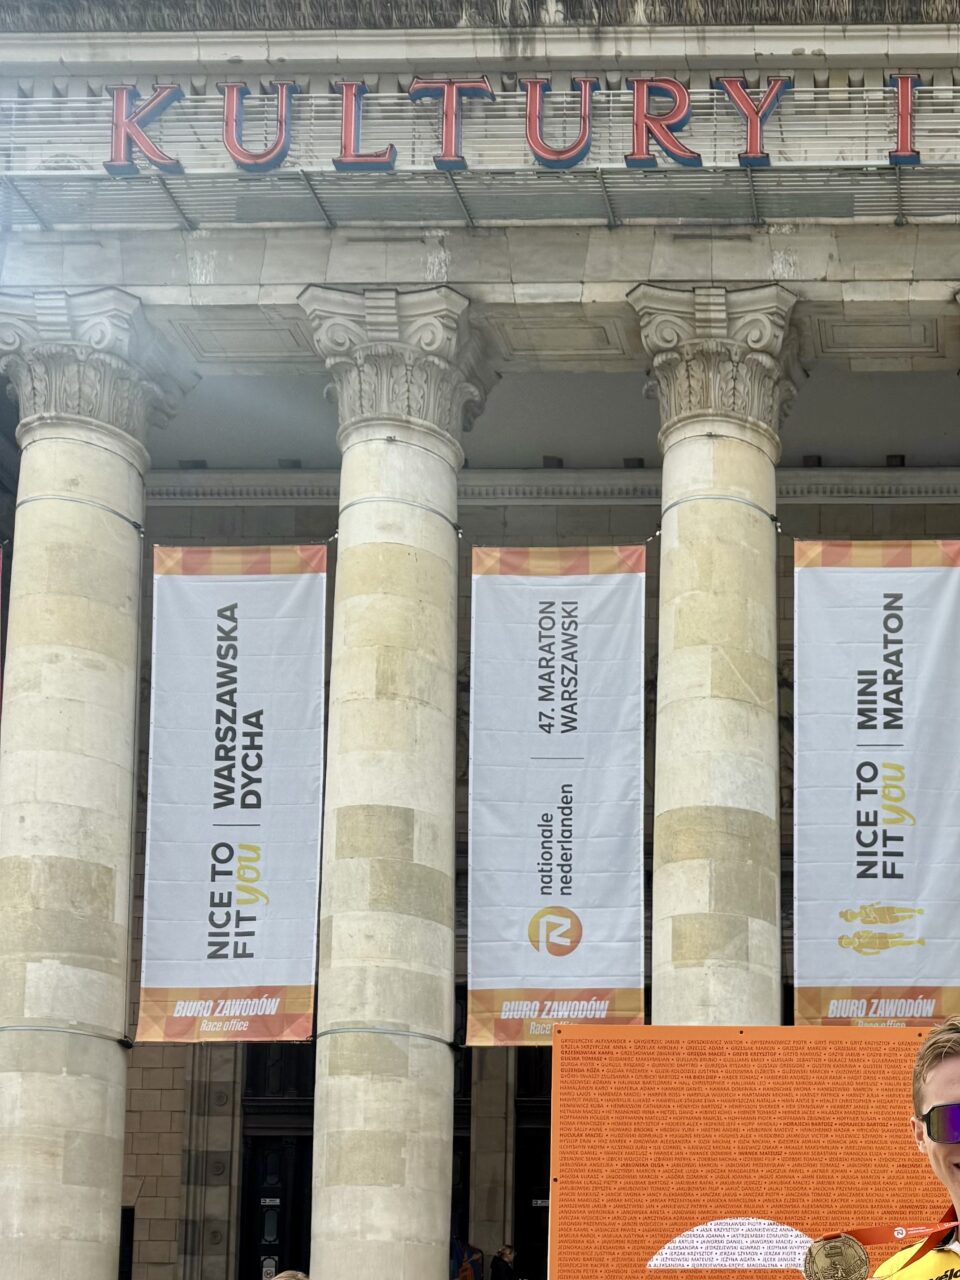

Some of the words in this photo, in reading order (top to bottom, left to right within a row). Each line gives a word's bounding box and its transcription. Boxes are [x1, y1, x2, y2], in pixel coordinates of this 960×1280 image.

[103, 74, 793, 174] KULTURY
[888, 73, 921, 165] I
[538, 601, 555, 701] MARATON
[561, 601, 578, 734] WARSZAWSKI
[883, 593, 904, 730] MARATON
[213, 602, 238, 809] WARSZAWSKA
[538, 708, 555, 734] 47.
[857, 670, 878, 730] MINI
[240, 709, 264, 809] DYCHA
[856, 761, 879, 801] TO
[881, 762, 916, 827] you
[211, 842, 234, 882] TO
[537, 812, 553, 896] nationale
[557, 783, 573, 896] nederlanden
[856, 810, 878, 879] NICE
[882, 829, 904, 879] FIT
[236, 843, 269, 906] you
[207, 891, 233, 959] NICE
[233, 910, 257, 958] FIT
[173, 1000, 213, 1017] BIURO
[214, 994, 280, 1017] ZAWODÓW
[200, 1019, 221, 1032] Race
[223, 1019, 249, 1032] office
[500, 1000, 539, 1019] BIURO
[541, 996, 609, 1019] ZAWODÓW
[530, 1022, 551, 1034] Race
[828, 999, 866, 1018] BIURO
[868, 995, 936, 1018] ZAWODÓW
